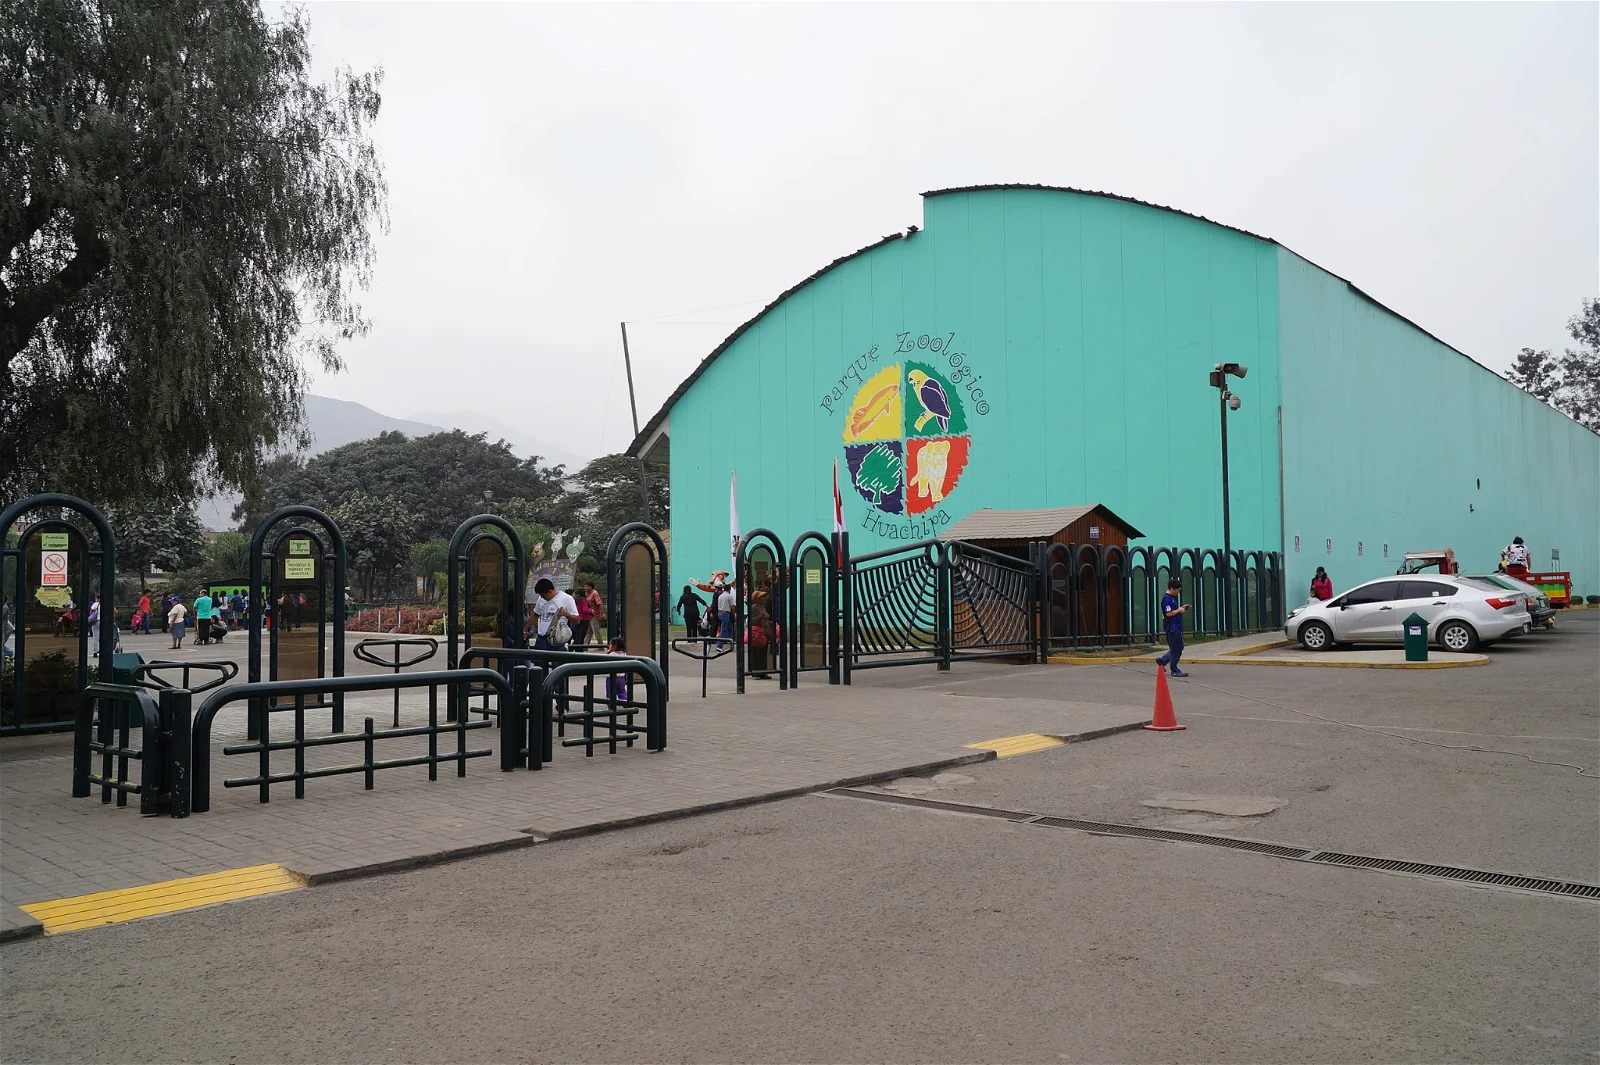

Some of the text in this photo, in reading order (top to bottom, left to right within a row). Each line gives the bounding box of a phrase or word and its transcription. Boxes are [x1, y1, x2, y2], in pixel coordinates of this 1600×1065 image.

[819, 331, 990, 417] Parque Zoológico
[861, 507, 952, 540] Huachipa
